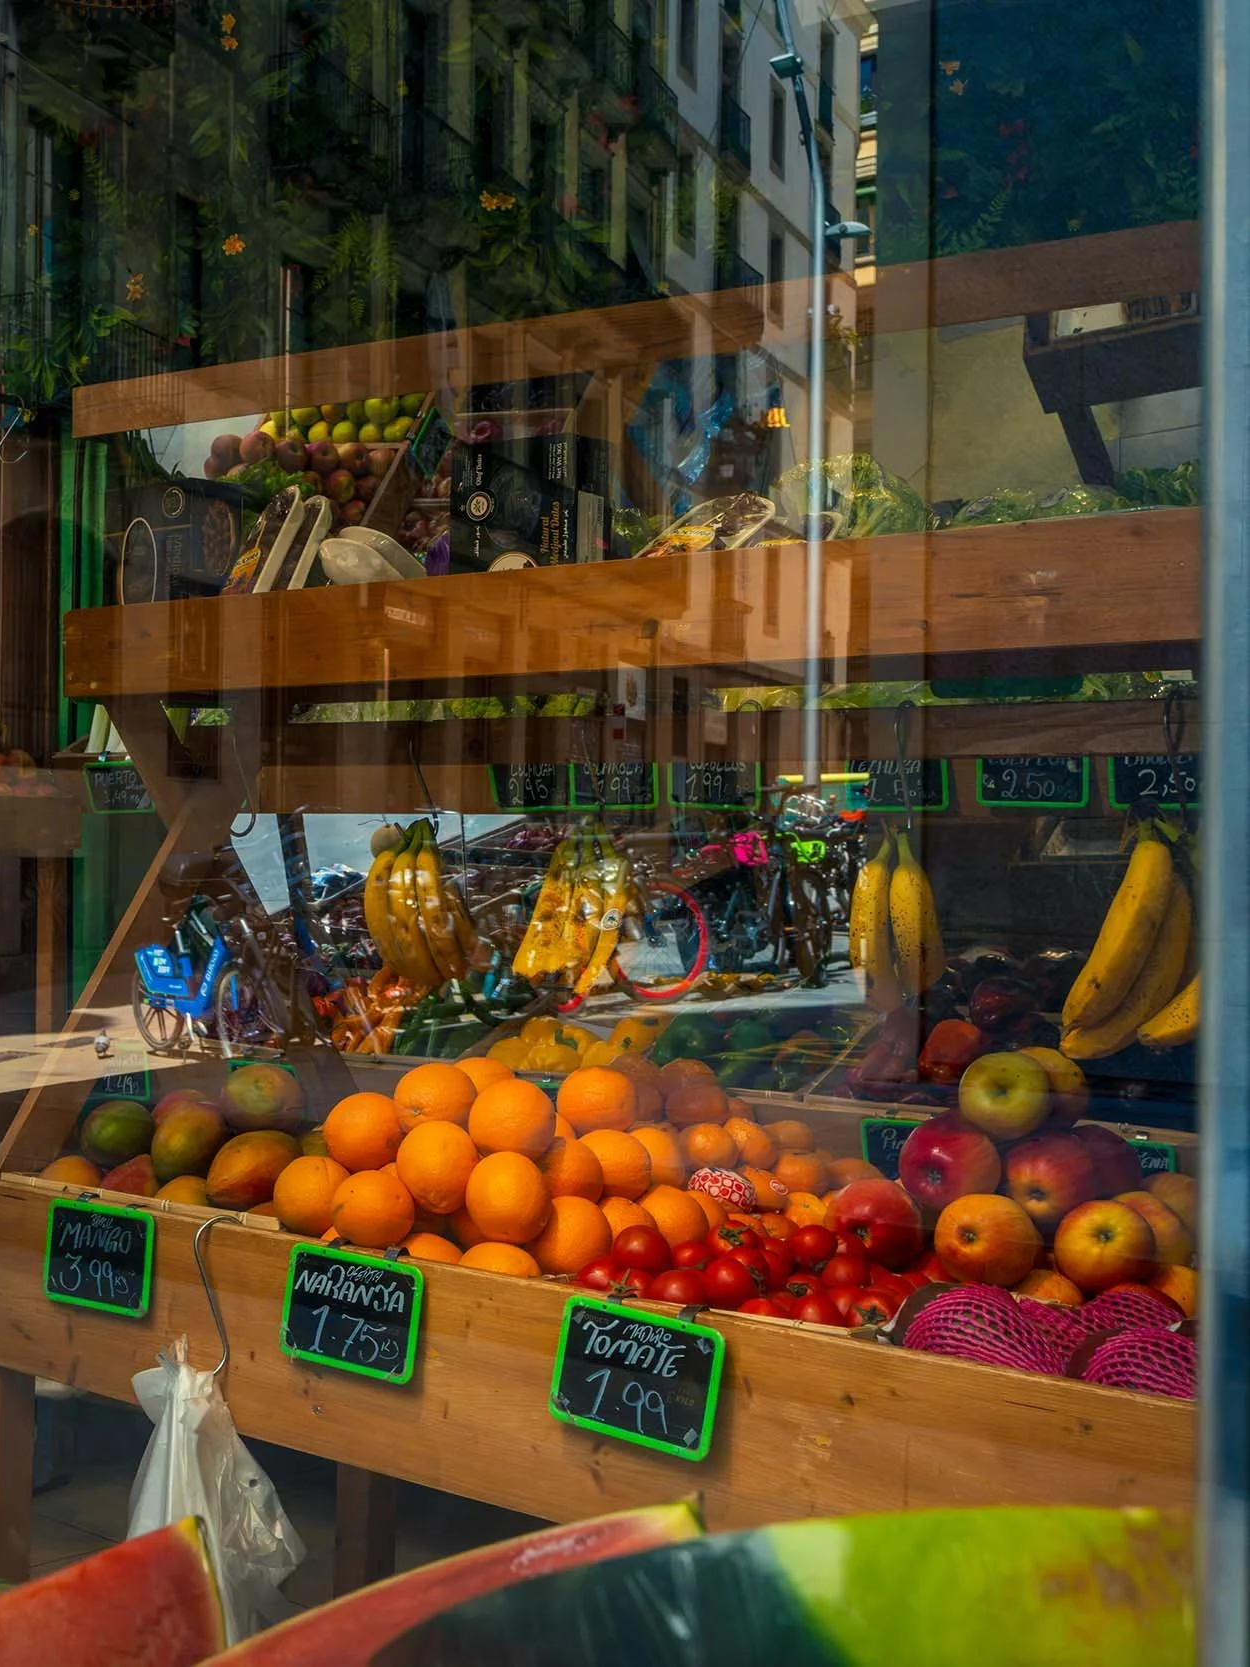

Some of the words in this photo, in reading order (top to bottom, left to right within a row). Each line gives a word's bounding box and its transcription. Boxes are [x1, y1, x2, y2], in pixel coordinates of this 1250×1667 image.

[1001, 768, 1056, 799] 2.50
[59, 1221, 132, 1255] MANGO
[58, 1252, 114, 1299] 3.99
[294, 1264, 406, 1313] NARANJA
[582, 1319, 687, 1378] TOMATE
[583, 1367, 669, 1435] 1.99
